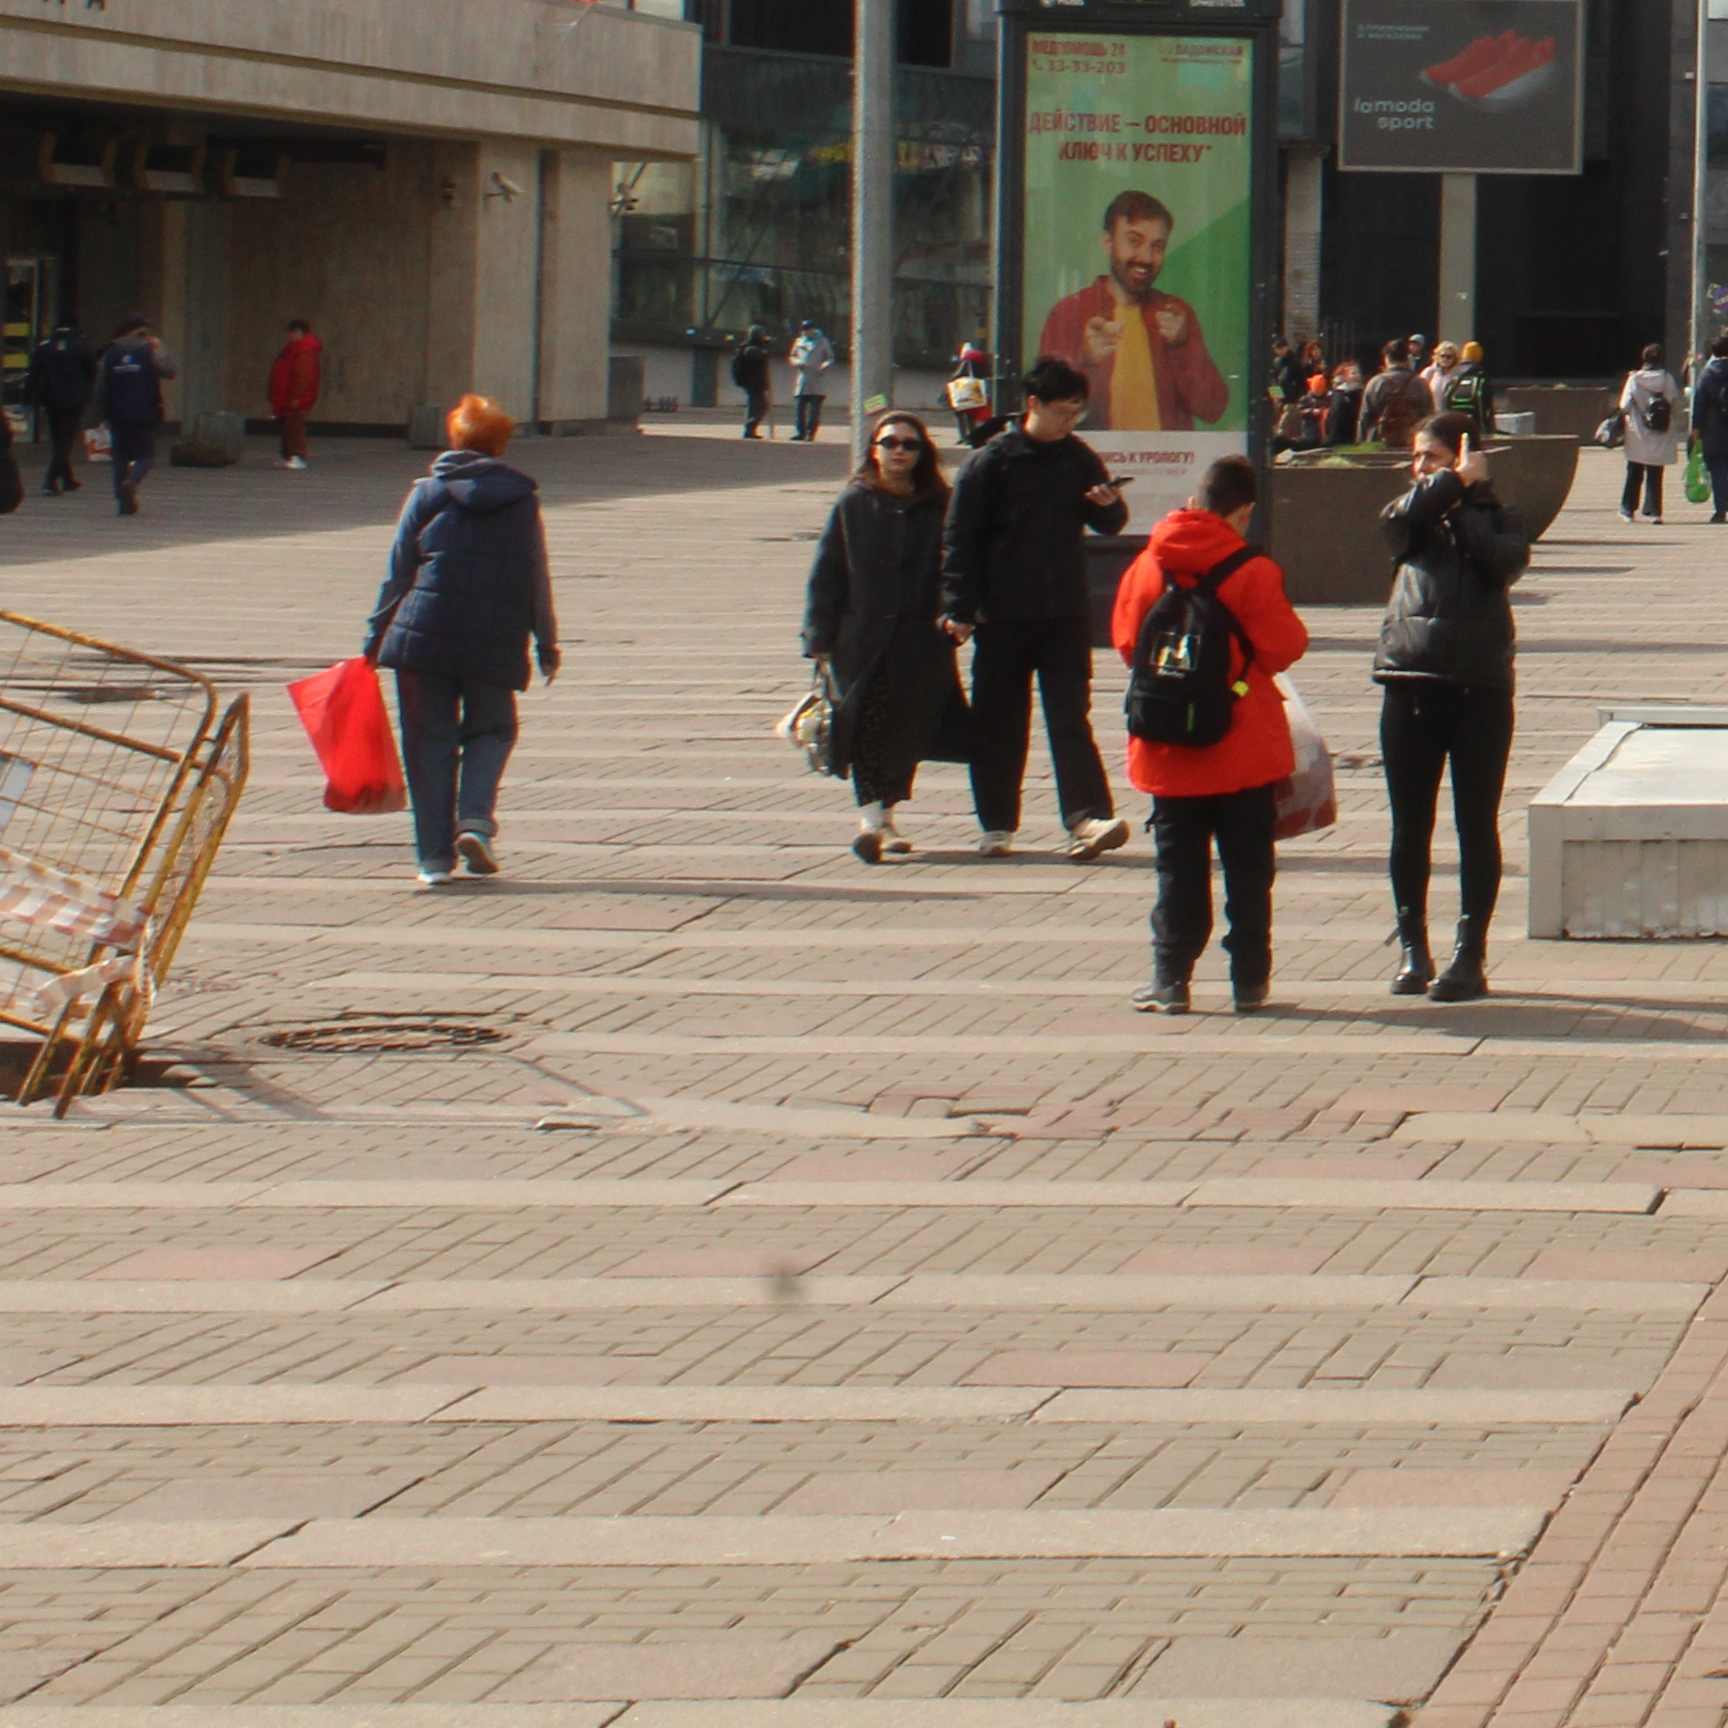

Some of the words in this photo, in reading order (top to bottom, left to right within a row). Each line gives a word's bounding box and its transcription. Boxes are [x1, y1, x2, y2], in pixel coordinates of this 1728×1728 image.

[1354, 98, 1435, 114] lamoda
[1028, 109, 1121, 135] ДЕЙСТВИЕ
[1144, 112, 1247, 136] ОСНОВНОЙ
[1377, 114, 1435, 131] sport
[1059, 141, 1112, 160] КЛЮЧ
[1116, 143, 1128, 160] К
